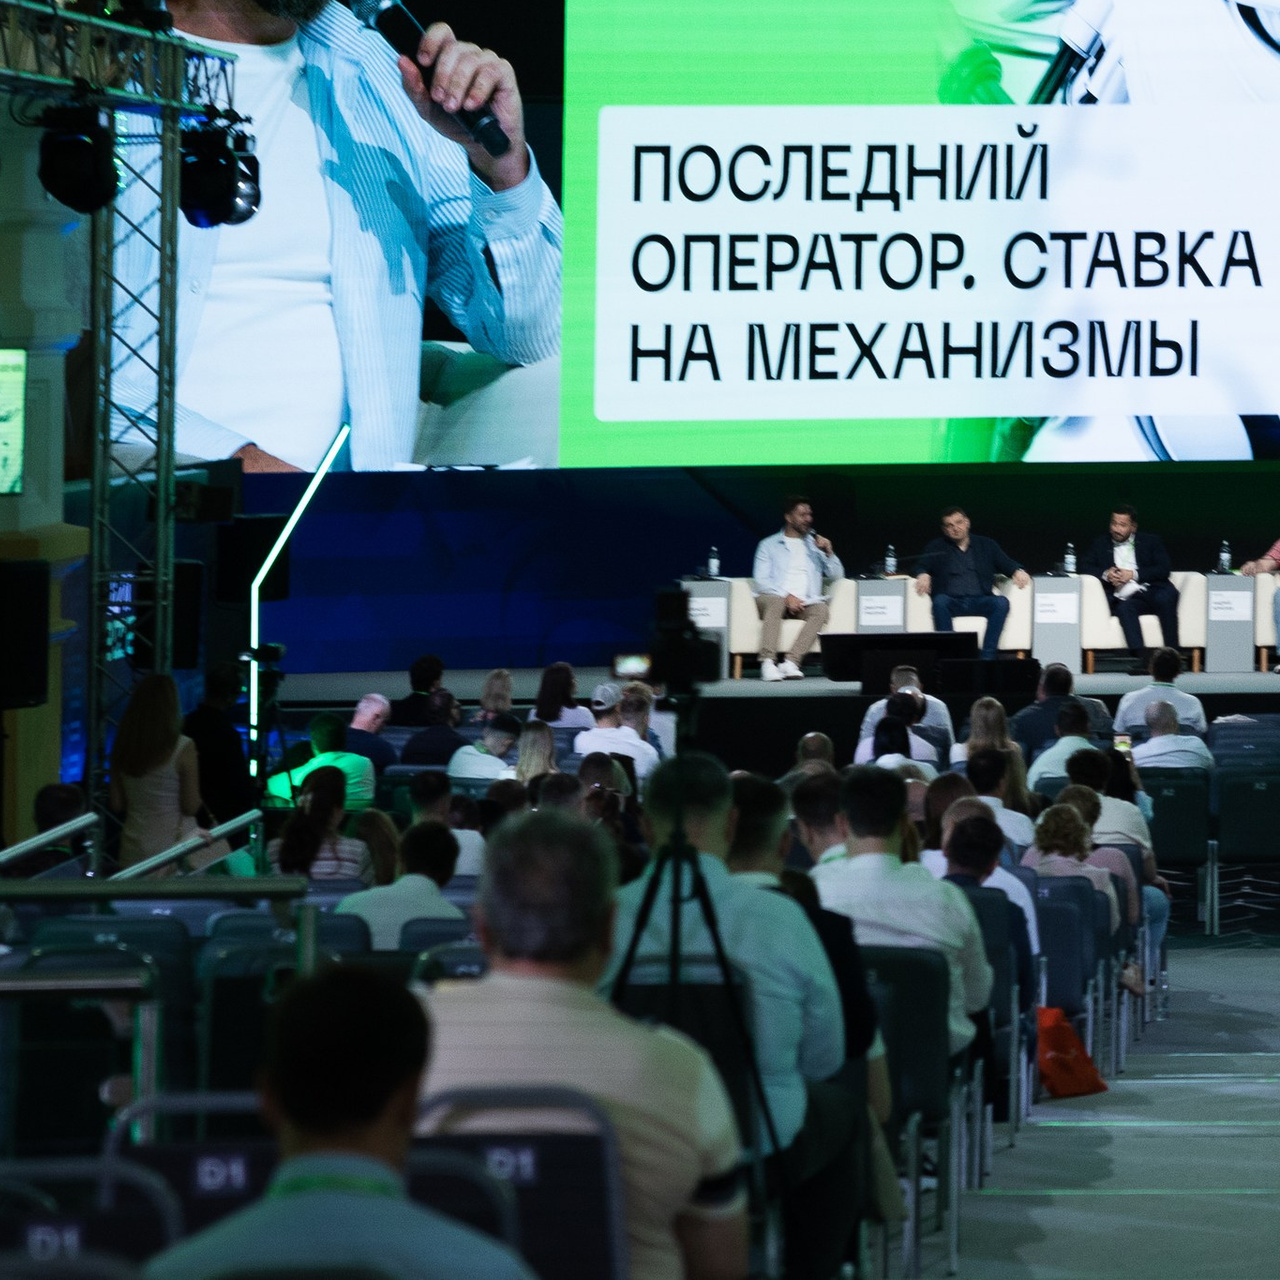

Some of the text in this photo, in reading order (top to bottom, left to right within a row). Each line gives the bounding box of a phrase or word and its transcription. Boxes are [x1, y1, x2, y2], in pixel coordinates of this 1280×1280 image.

[632, 124, 1049, 211] ПОСЛЕДНИЙ
[631, 229, 1262, 292] ОПЕРАТОР. СТАВКА
[630, 319, 1199, 381] НА МЕХАНИЗМЫ
[196, 1155, 246, 1191] D1
